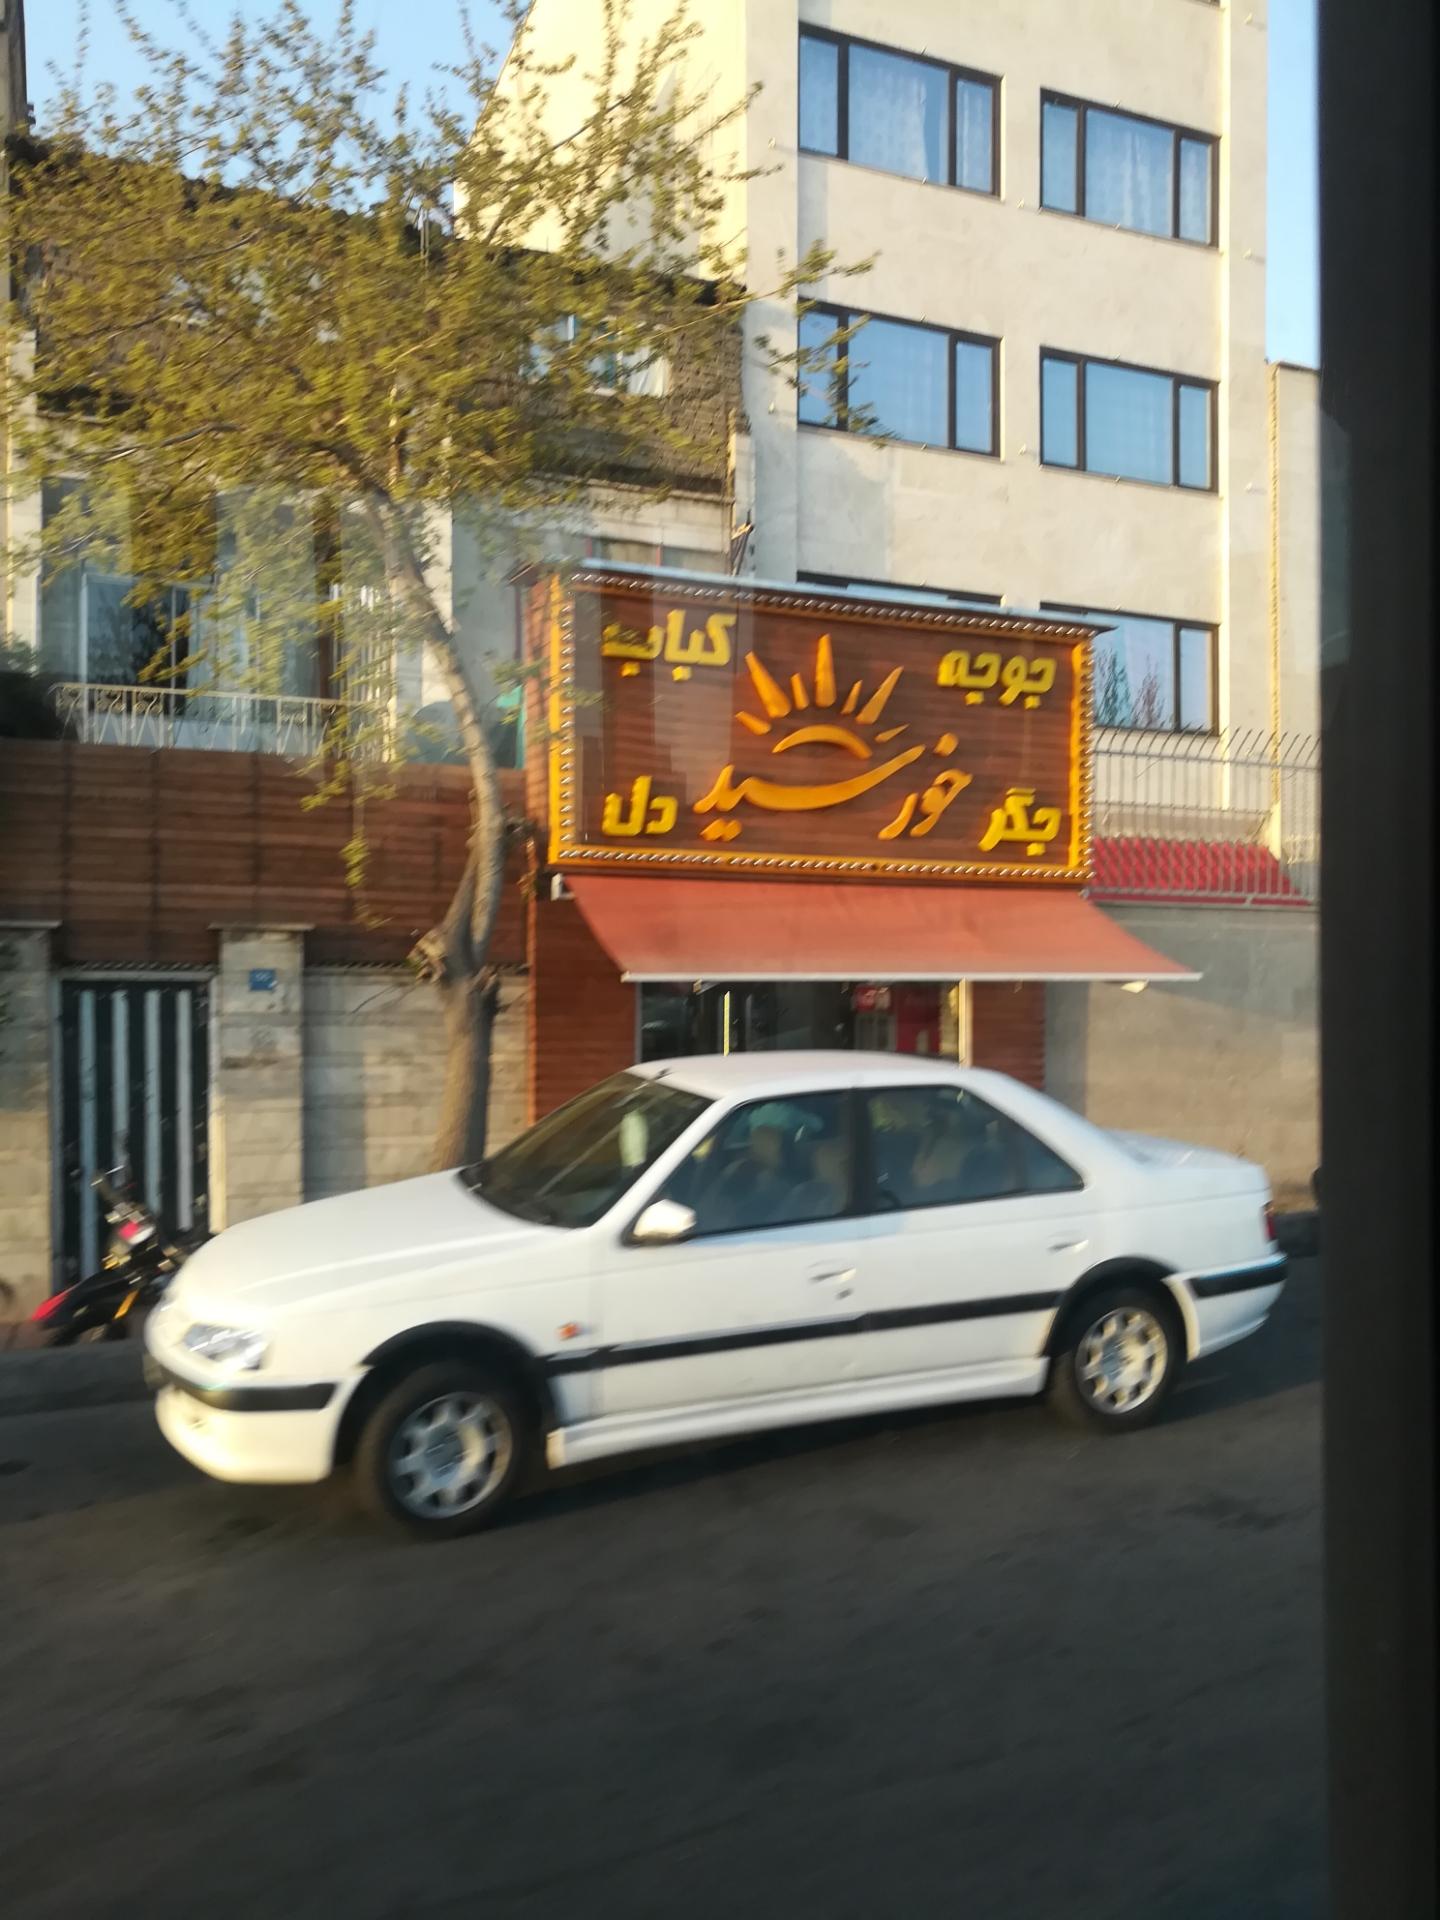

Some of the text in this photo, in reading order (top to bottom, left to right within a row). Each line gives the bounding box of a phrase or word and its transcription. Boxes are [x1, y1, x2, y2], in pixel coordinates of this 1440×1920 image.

[601, 608, 737, 682] کباب
[936, 650, 1058, 710] جوجه
[601, 775, 679, 837] دل
[977, 787, 1062, 857] جگر
